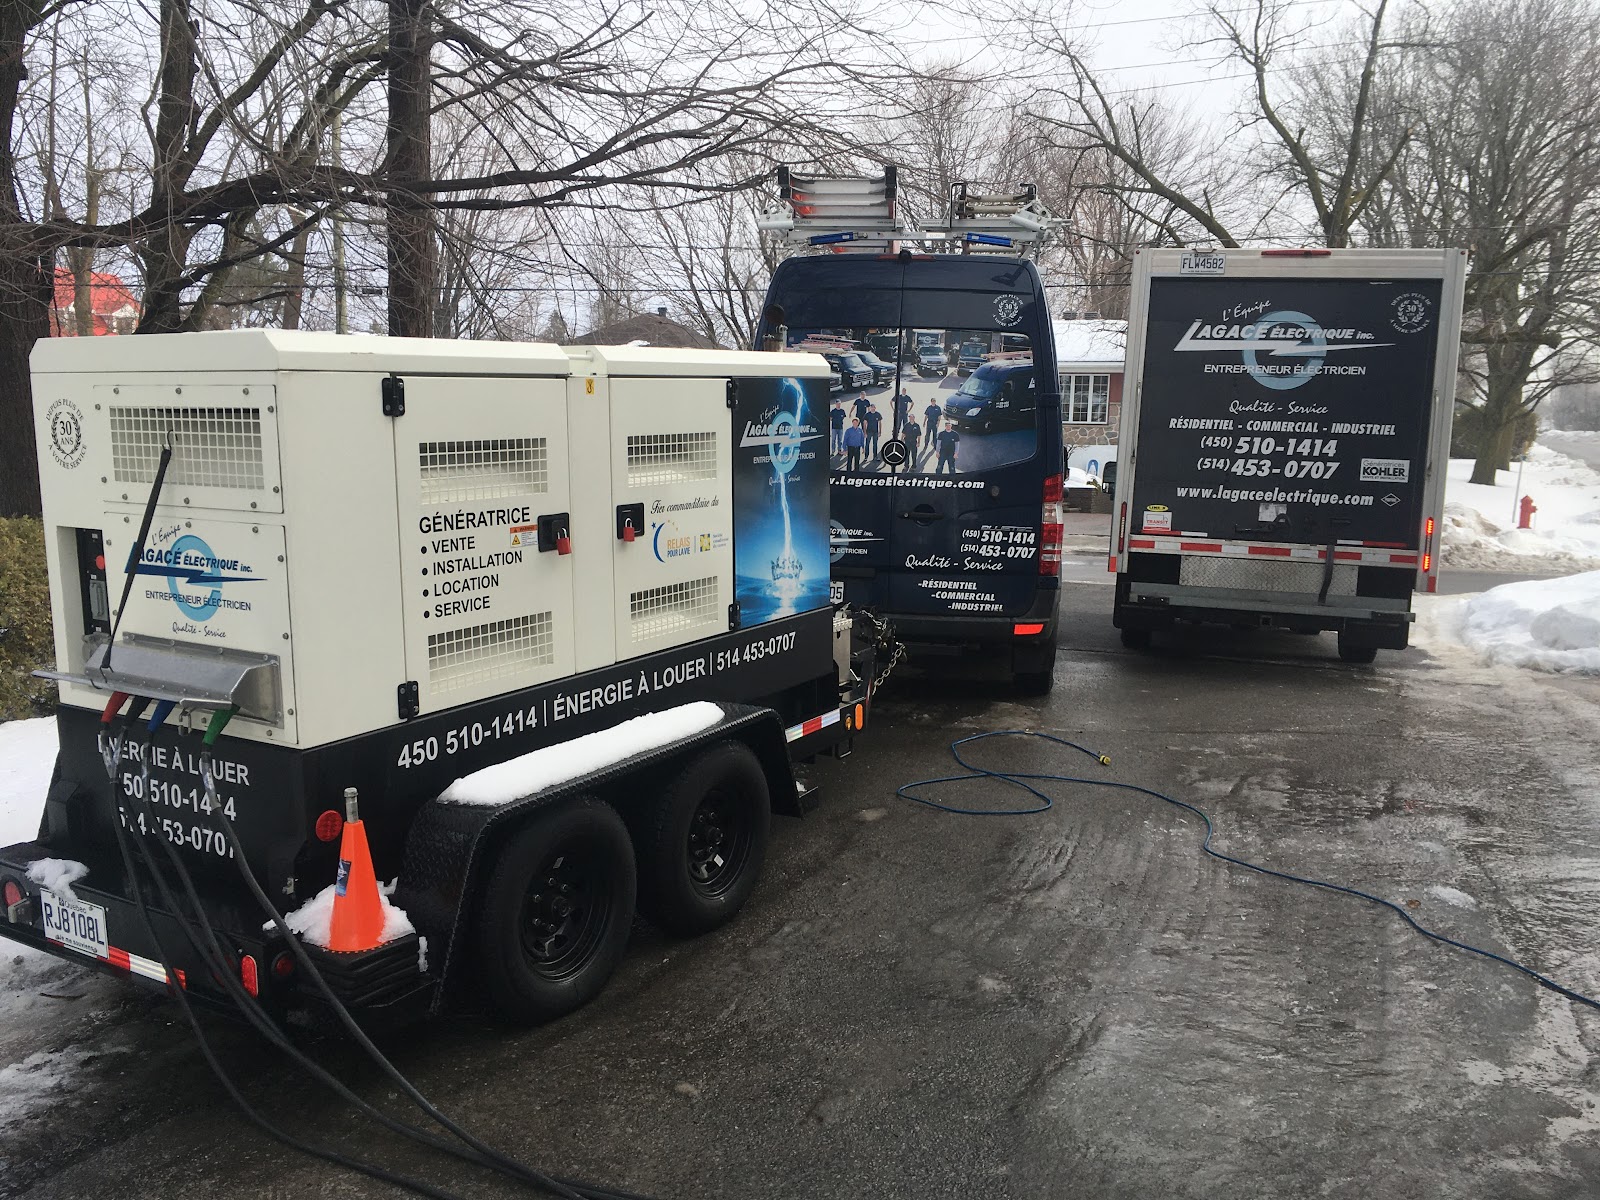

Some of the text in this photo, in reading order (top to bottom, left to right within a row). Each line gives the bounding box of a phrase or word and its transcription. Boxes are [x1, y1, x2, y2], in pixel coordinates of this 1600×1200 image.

[1182, 257, 1224, 269] FLW4582
[1222, 300, 1271, 321] L'Équipe
[1406, 304, 1416, 312] 30
[1174, 319, 1375, 351] LAGACÉ ÉLECTRIQUE inc.
[1204, 364, 1366, 375] ENTREPRENEUR ÉLECTRICIEN
[46, 399, 62, 421] DEPUIS
[62, 399, 76, 411] PLUS
[1229, 400, 1275, 414] Qualité
[1288, 401, 1328, 414] Service
[60, 420, 72, 436] 30
[1169, 416, 1234, 430] RÉSIDENTIEL
[1246, 420, 1318, 432] COMMERCIAL
[1330, 422, 1396, 436] INDUSTRIEL
[60, 437, 74, 446] ANS
[1200, 436, 1338, 456] (450) 510-1414
[52, 451, 70, 469] VOTRE
[70, 444, 87, 470] SERVICE
[1197, 458, 1340, 480] (514) 453-0707
[1362, 466, 1406, 476] KOHLER
[650, 495, 719, 514] Fier commanditaire du
[1176, 485, 1374, 506] www.lagaceelectrique.com
[419, 506, 530, 534] GÉNÉRATRICE
[152, 524, 181, 546] L'Équipe
[667, 536, 690, 550] RELAIS
[962, 530, 1036, 544] (450) 510-1414
[432, 536, 476, 554] VENTE
[667, 548, 678, 558] POUR
[960, 544, 1036, 558] (514) 453-0707
[184, 554, 238, 570] ÉLECTRIQUE
[240, 564, 252, 573] inc.
[433, 550, 522, 576] INSTALLATION
[905, 554, 951, 570] Qualité
[963, 556, 1004, 570] Service
[434, 574, 499, 597] LOCATION
[918, 579, 977, 590] -RÉSIDENTIEL
[146, 590, 251, 611] ENTREPRENEUR ÉLECTRICIEN
[931, 591, 995, 602] -COMMERCIAL
[434, 596, 490, 618] SERVICE
[948, 602, 1004, 612] -INDUSTRIEL
[172, 622, 196, 634] Qualité
[204, 626, 226, 638] Service
[398, 736, 438, 769] 450
[446, 706, 538, 754] 510-1414
[553, 678, 633, 721] ÉNERGIE
[636, 670, 650, 696] À
[654, 657, 706, 691] LOUER
[716, 648, 740, 671] 514
[742, 632, 796, 664] 453-0707
[172, 746, 184, 772] À
[118, 772, 144, 799] 50
[150, 779, 237, 821] 510-144
[152, 816, 234, 859] 53-070
